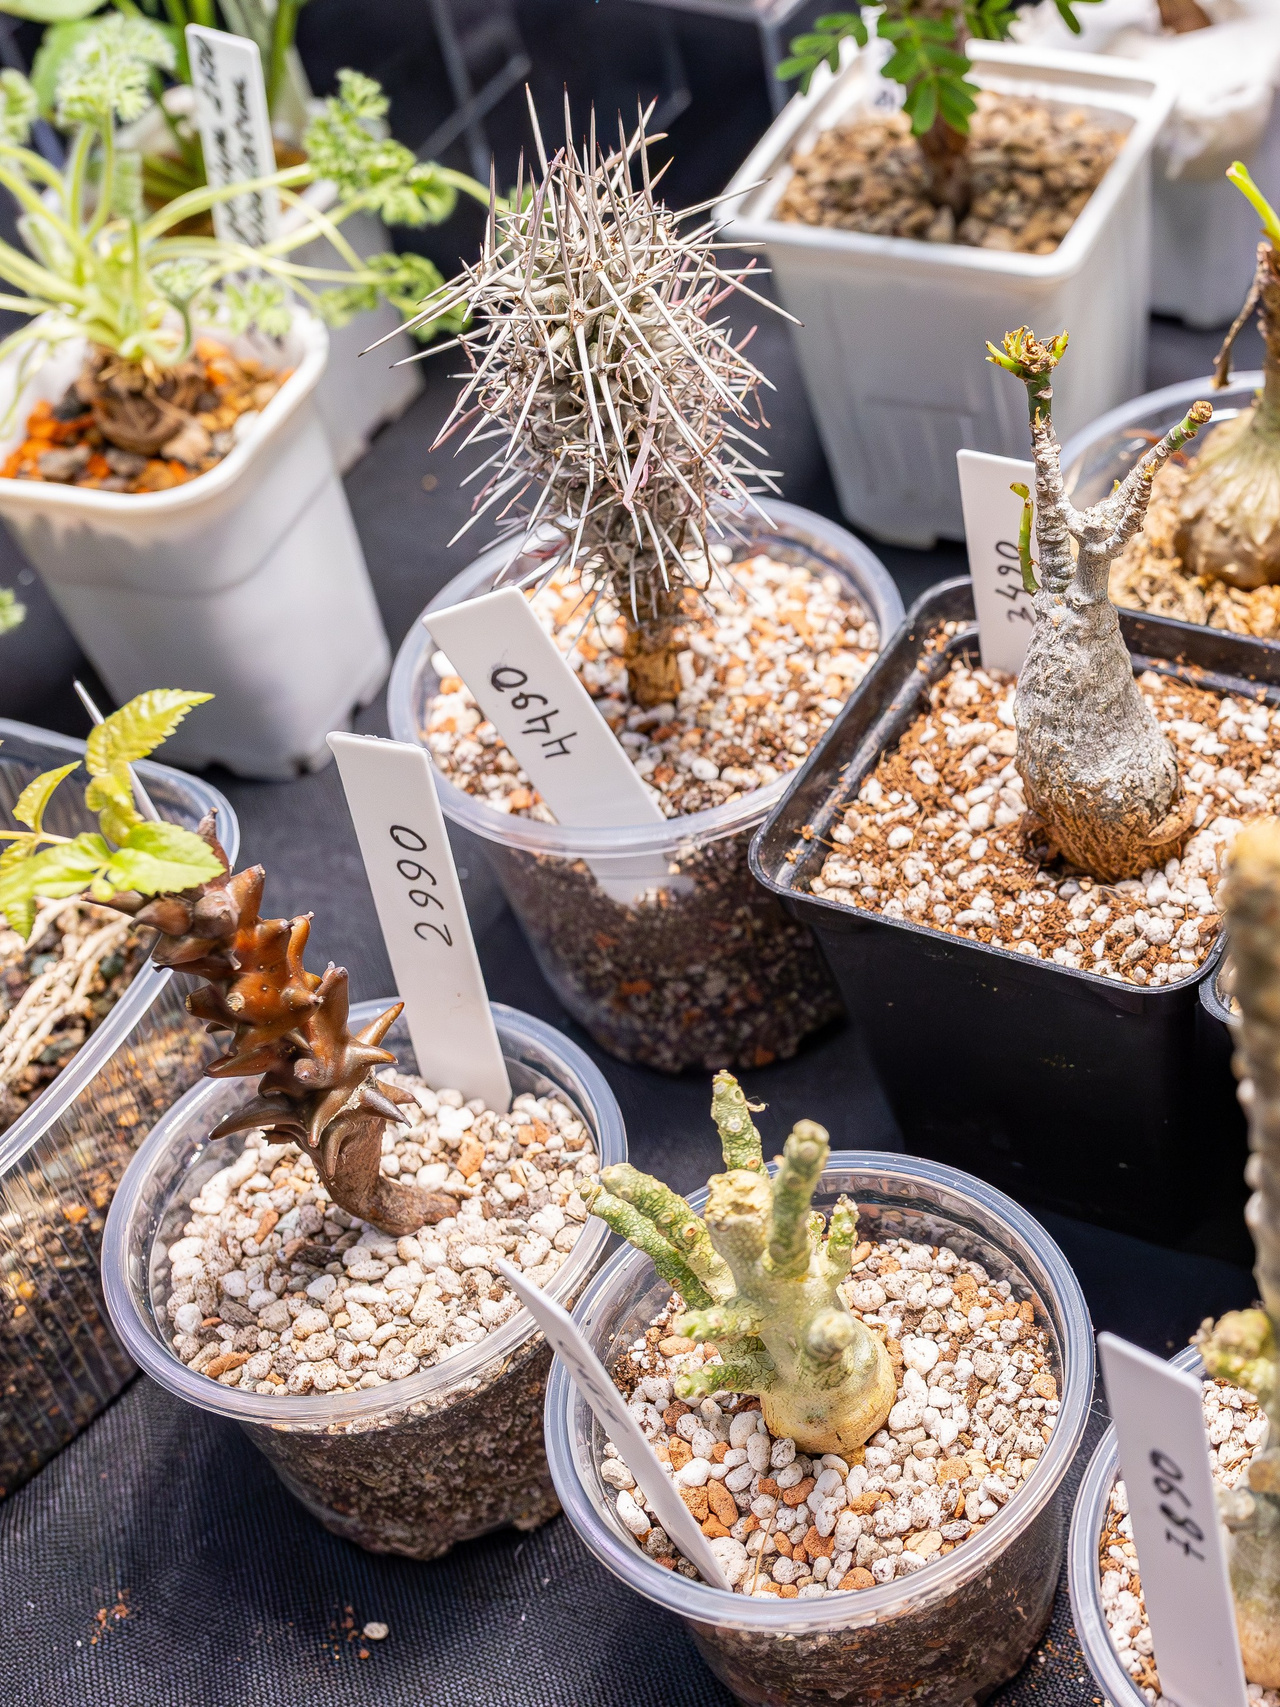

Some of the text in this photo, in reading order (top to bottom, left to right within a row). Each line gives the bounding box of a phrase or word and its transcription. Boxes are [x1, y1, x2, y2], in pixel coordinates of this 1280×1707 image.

[490, 665, 578, 759] 4490
[389, 824, 453, 947] 2990
[1149, 1448, 1206, 1562] 7890
